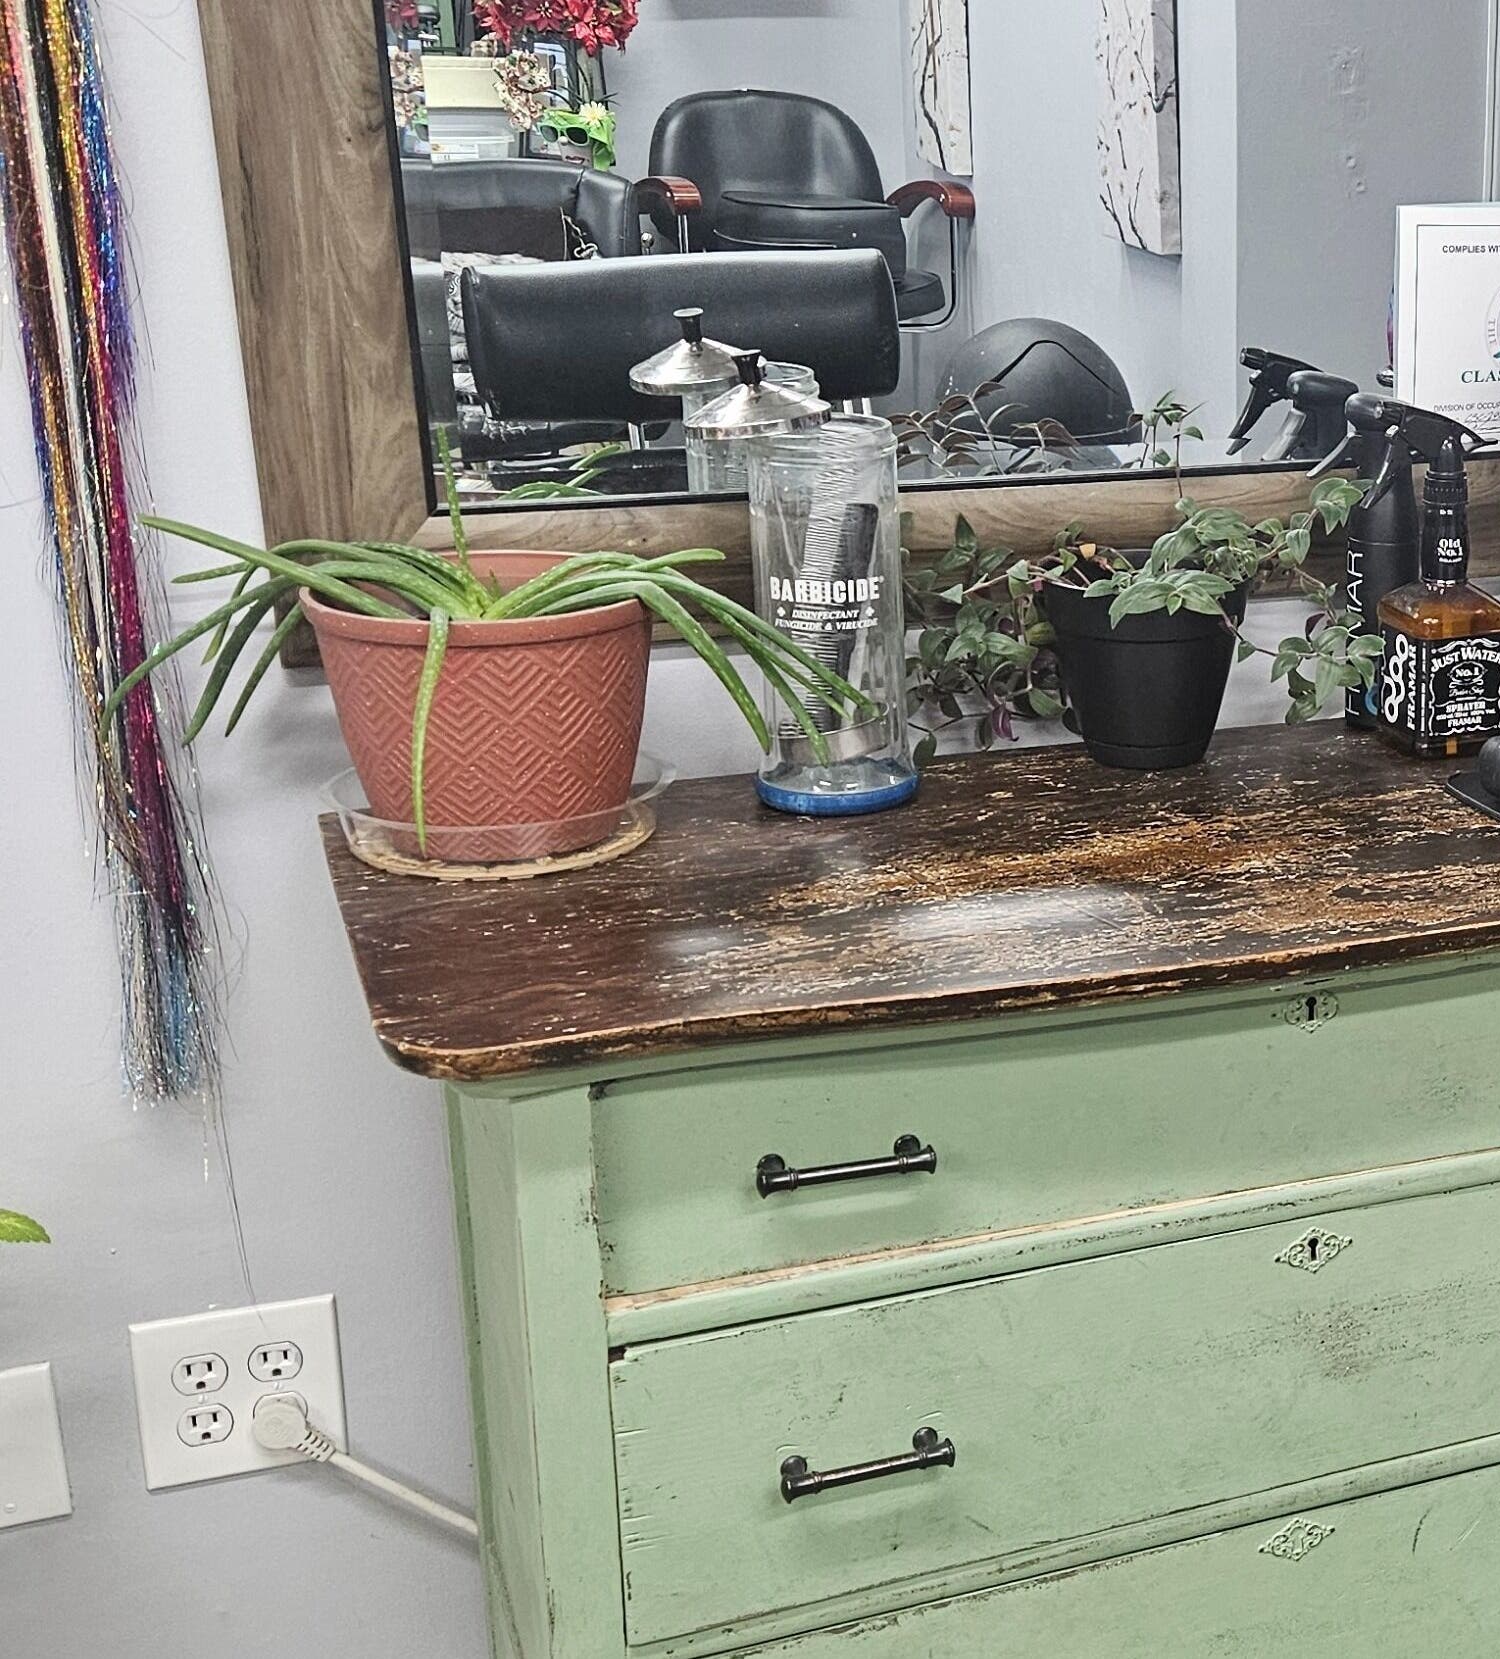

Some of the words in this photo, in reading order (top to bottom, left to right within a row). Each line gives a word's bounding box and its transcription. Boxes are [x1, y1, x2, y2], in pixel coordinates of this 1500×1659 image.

[1442, 245, 1486, 253] COMPLIES
[1433, 404, 1465, 413] DIVISION
[1465, 403, 1475, 411] OF
[1439, 538, 1461, 550] Old
[769, 575, 881, 603] BARBICIDE
[792, 609, 860, 619] DISINFECTANT
[774, 618, 823, 631] FUNGICIDE
[825, 622, 833, 631] &
[835, 618, 878, 630] VIRUCIDE
[1431, 651, 1461, 673] JUST
[1406, 644, 1416, 731] FRAMAR
[1446, 701, 1486, 713] SPRAYER
[1447, 716, 1482, 728] FRAMAR
